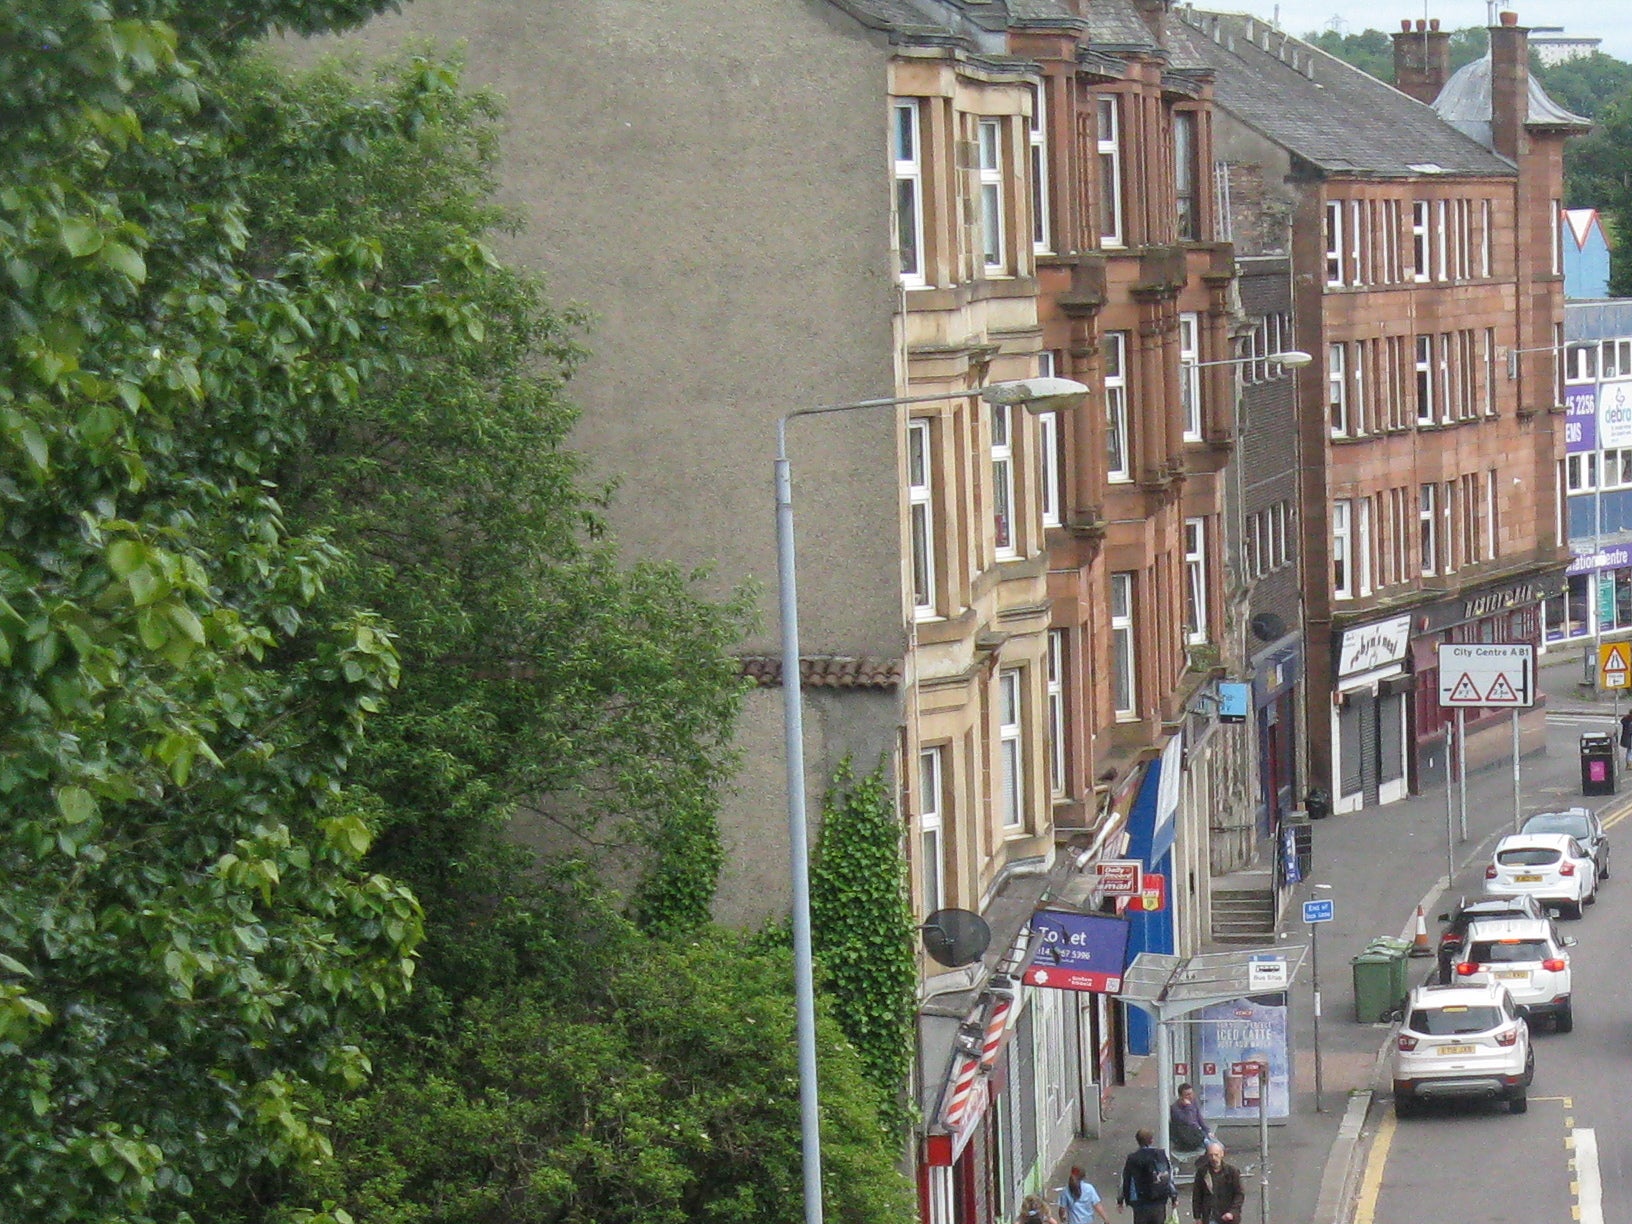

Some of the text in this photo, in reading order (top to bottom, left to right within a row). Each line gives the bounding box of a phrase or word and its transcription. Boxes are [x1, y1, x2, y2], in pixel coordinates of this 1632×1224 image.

[1576, 394, 1595, 415] 2256
[1605, 404, 1632, 423] debra
[1454, 648, 1472, 657] City
[1476, 647, 1507, 657] Centre
[1039, 926, 1059, 943] To
[1217, 1029, 1273, 1041] ICED LATTE
